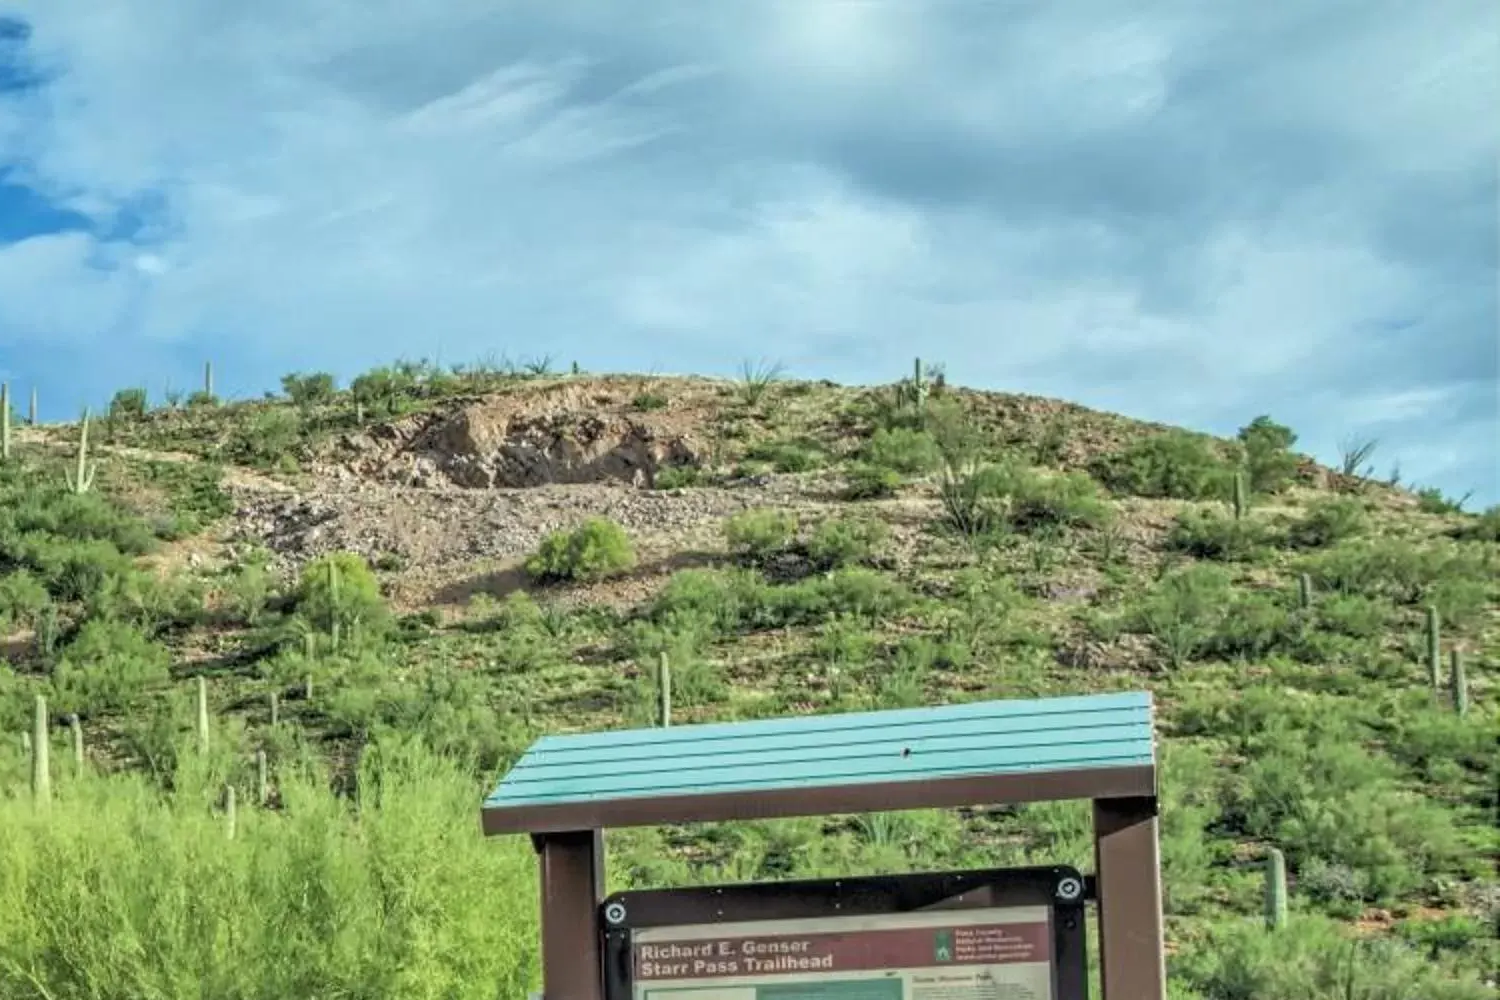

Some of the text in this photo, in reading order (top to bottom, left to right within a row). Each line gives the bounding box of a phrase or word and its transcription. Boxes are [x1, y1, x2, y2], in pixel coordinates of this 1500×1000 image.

[641, 940, 810, 960] Richard E. Genser
[641, 953, 833, 977] Starr Pass Trailhead
